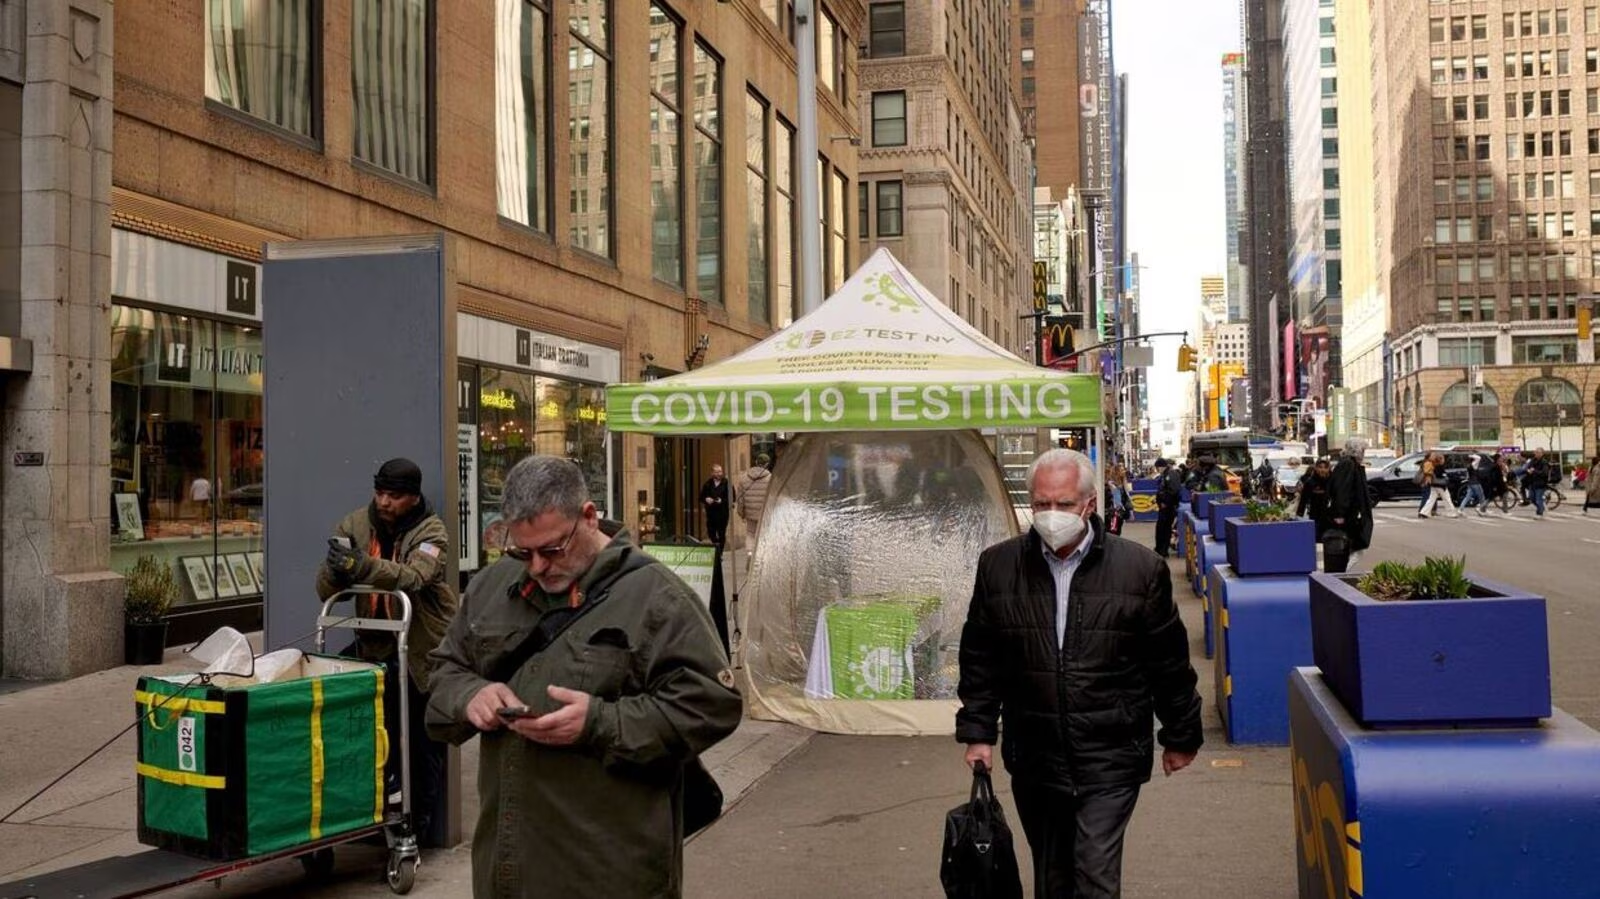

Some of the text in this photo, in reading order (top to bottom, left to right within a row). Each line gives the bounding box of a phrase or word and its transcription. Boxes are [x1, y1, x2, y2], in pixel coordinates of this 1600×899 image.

[1086, 121, 1094, 190] SQUARE
[235, 275, 249, 301] IT
[830, 328, 954, 344] EZ TEST NY
[167, 342, 186, 368] IT
[519, 338, 589, 368] IT ITALIAN TRATTORIA
[780, 359, 842, 368] PAINLESS
[813, 351, 872, 360] COVID-19
[457, 379, 471, 409] IT
[631, 382, 1072, 426] COVID-19 TESTING
[182, 727, 193, 753] 042
